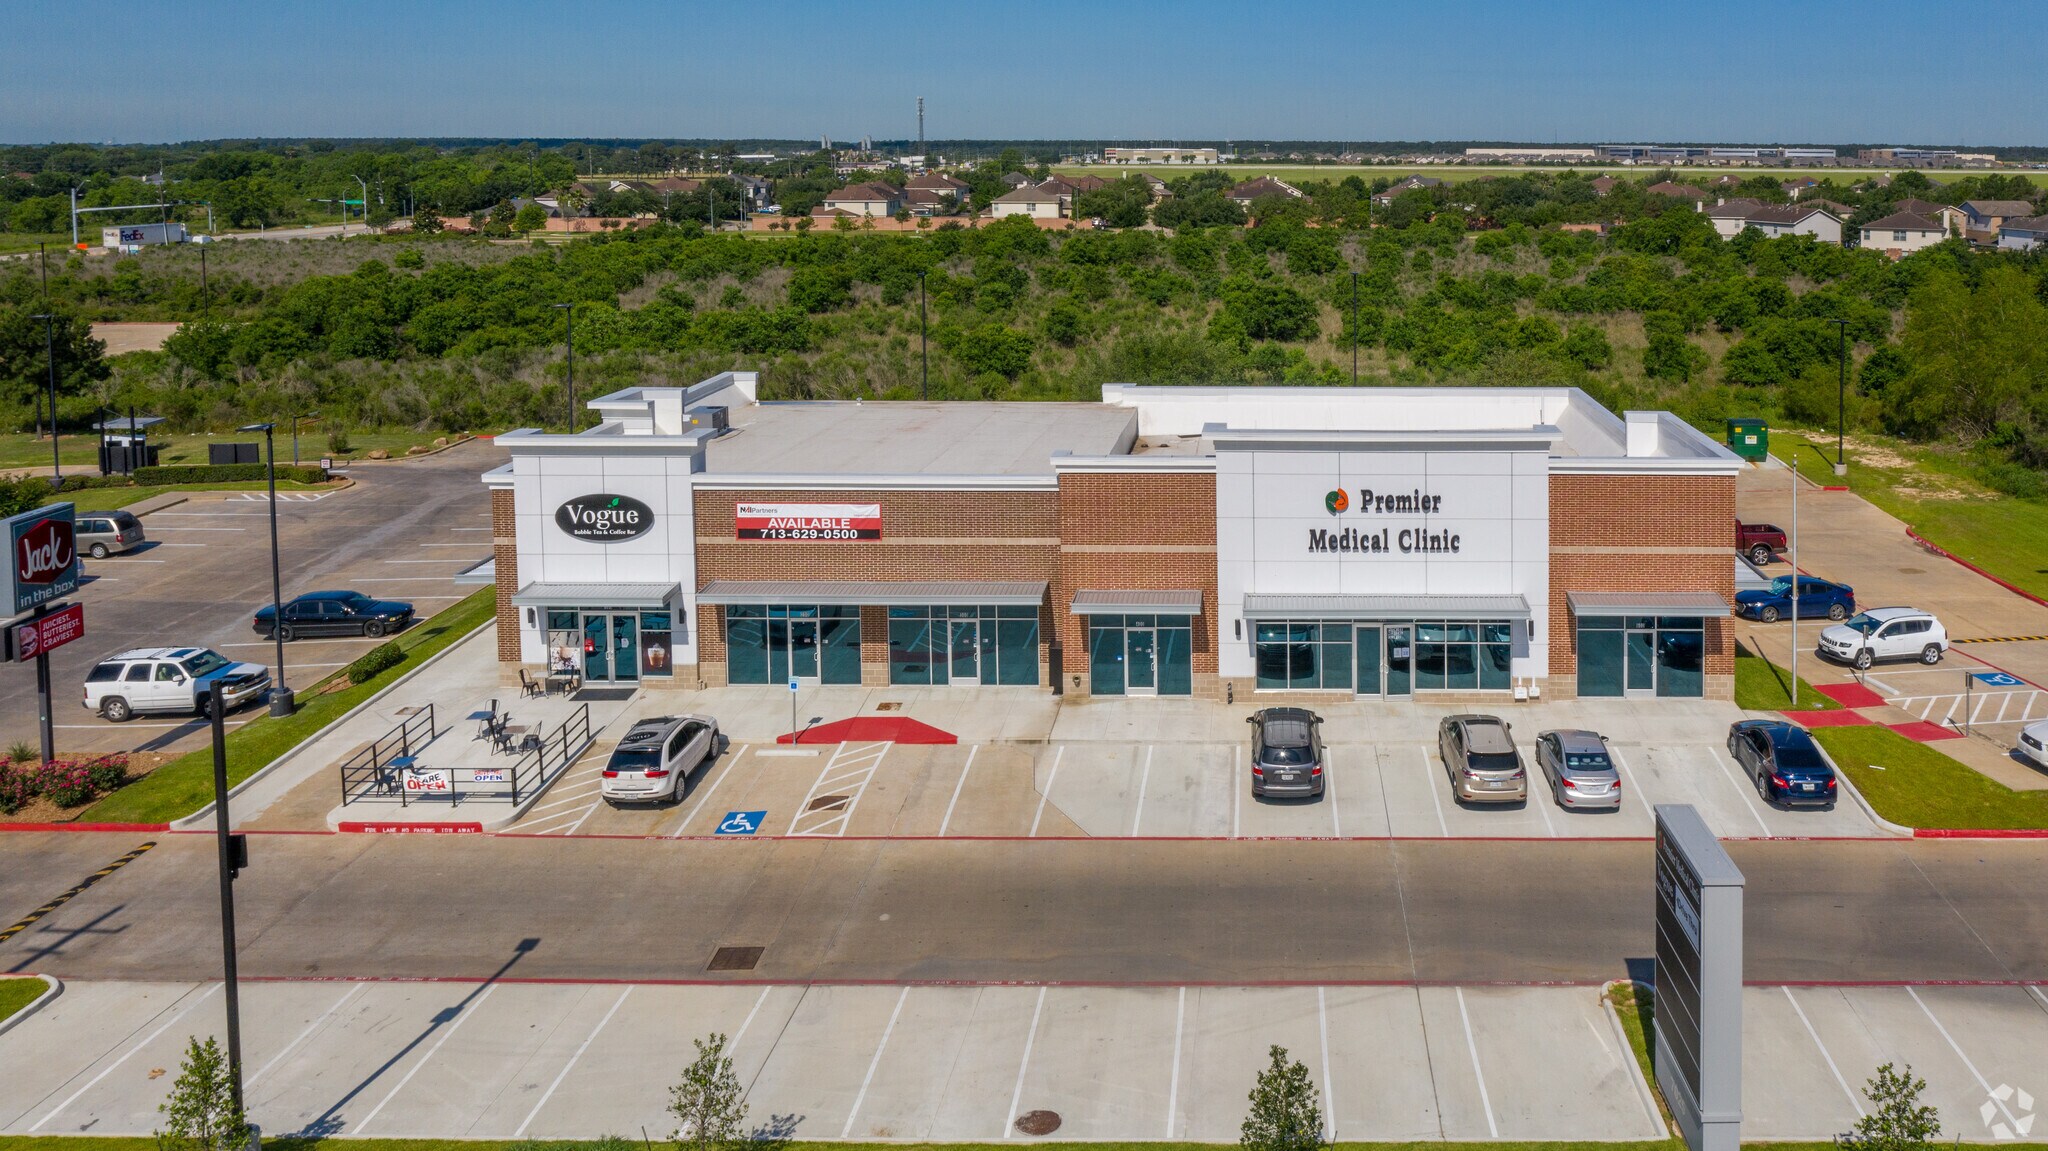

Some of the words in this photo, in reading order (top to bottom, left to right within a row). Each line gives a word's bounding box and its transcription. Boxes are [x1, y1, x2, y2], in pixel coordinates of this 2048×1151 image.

[120, 230, 144, 242] FedEx
[1360, 488, 1442, 513] Premier
[565, 504, 639, 530] Vogue
[767, 518, 851, 529] AVAILABLE
[760, 529, 858, 539] 713-629-0500
[1308, 527, 1390, 553] Medical
[1398, 527, 1461, 553] Clinic
[22, 526, 72, 580] Jack
[20, 595, 32, 607] in
[33, 587, 53, 602] the
[54, 579, 75, 594] box
[42, 613, 71, 631] JUICIEST.
[43, 619, 80, 639] BUTTERIEST.
[43, 631, 75, 648] CRAVIEST.
[407, 779, 446, 791] OPEN
[422, 773, 442, 784] ARE
